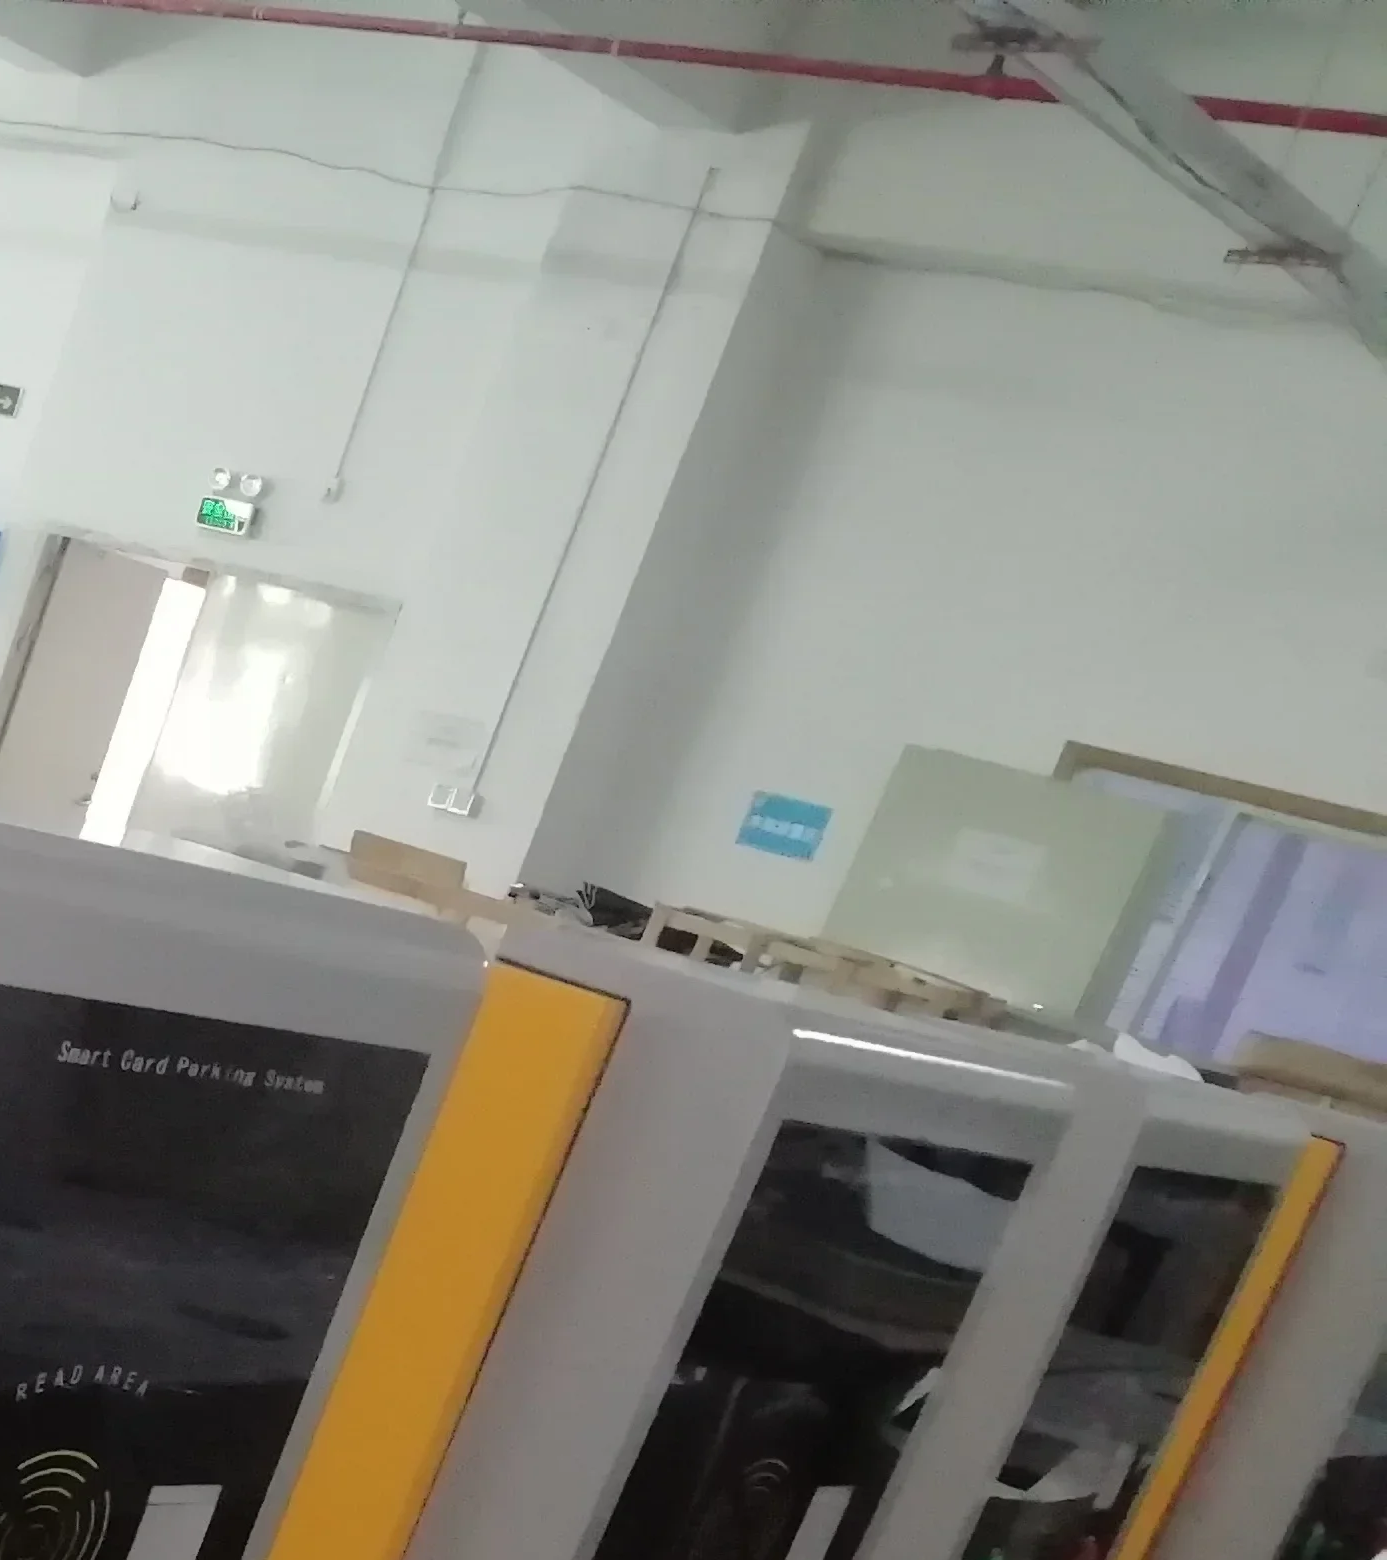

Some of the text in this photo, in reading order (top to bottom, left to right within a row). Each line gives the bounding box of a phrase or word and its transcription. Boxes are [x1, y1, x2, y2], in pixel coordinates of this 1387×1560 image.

[56, 1040, 325, 1095] Smart Card Parking System
[15, 1364, 149, 1402] READ AREA
